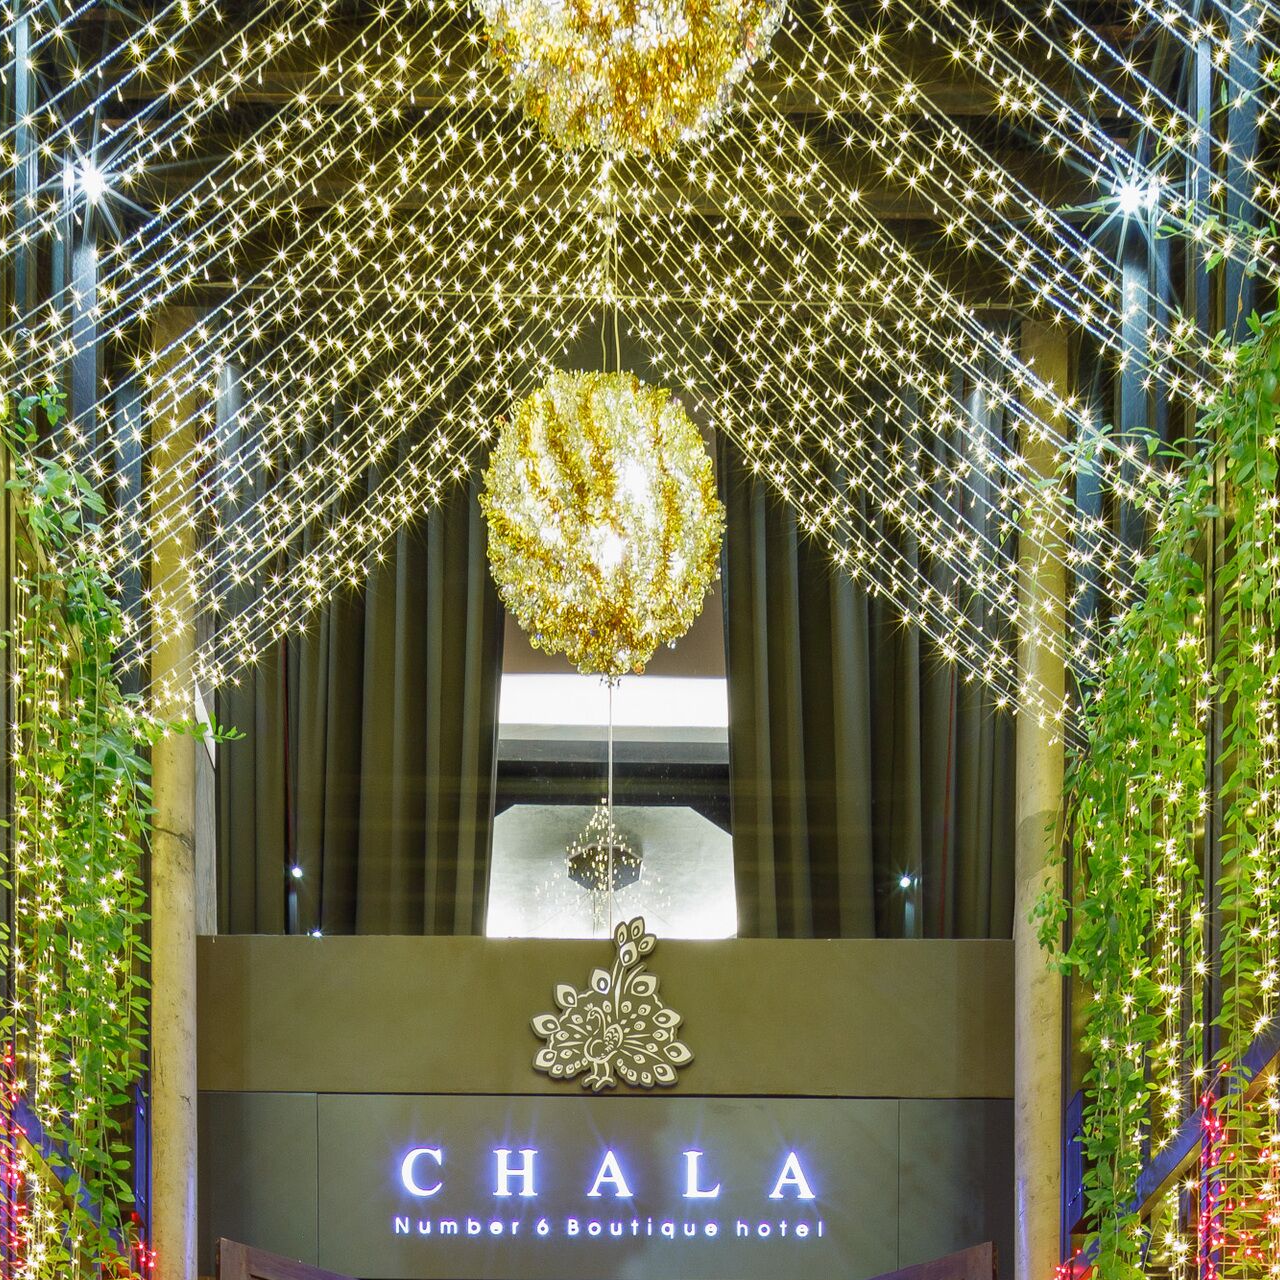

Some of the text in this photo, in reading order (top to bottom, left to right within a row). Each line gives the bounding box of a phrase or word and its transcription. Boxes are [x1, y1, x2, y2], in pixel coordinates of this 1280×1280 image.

[401, 1148, 816, 1199] CHALA
[395, 1217, 824, 1239] Number 6 Boutique hotel
